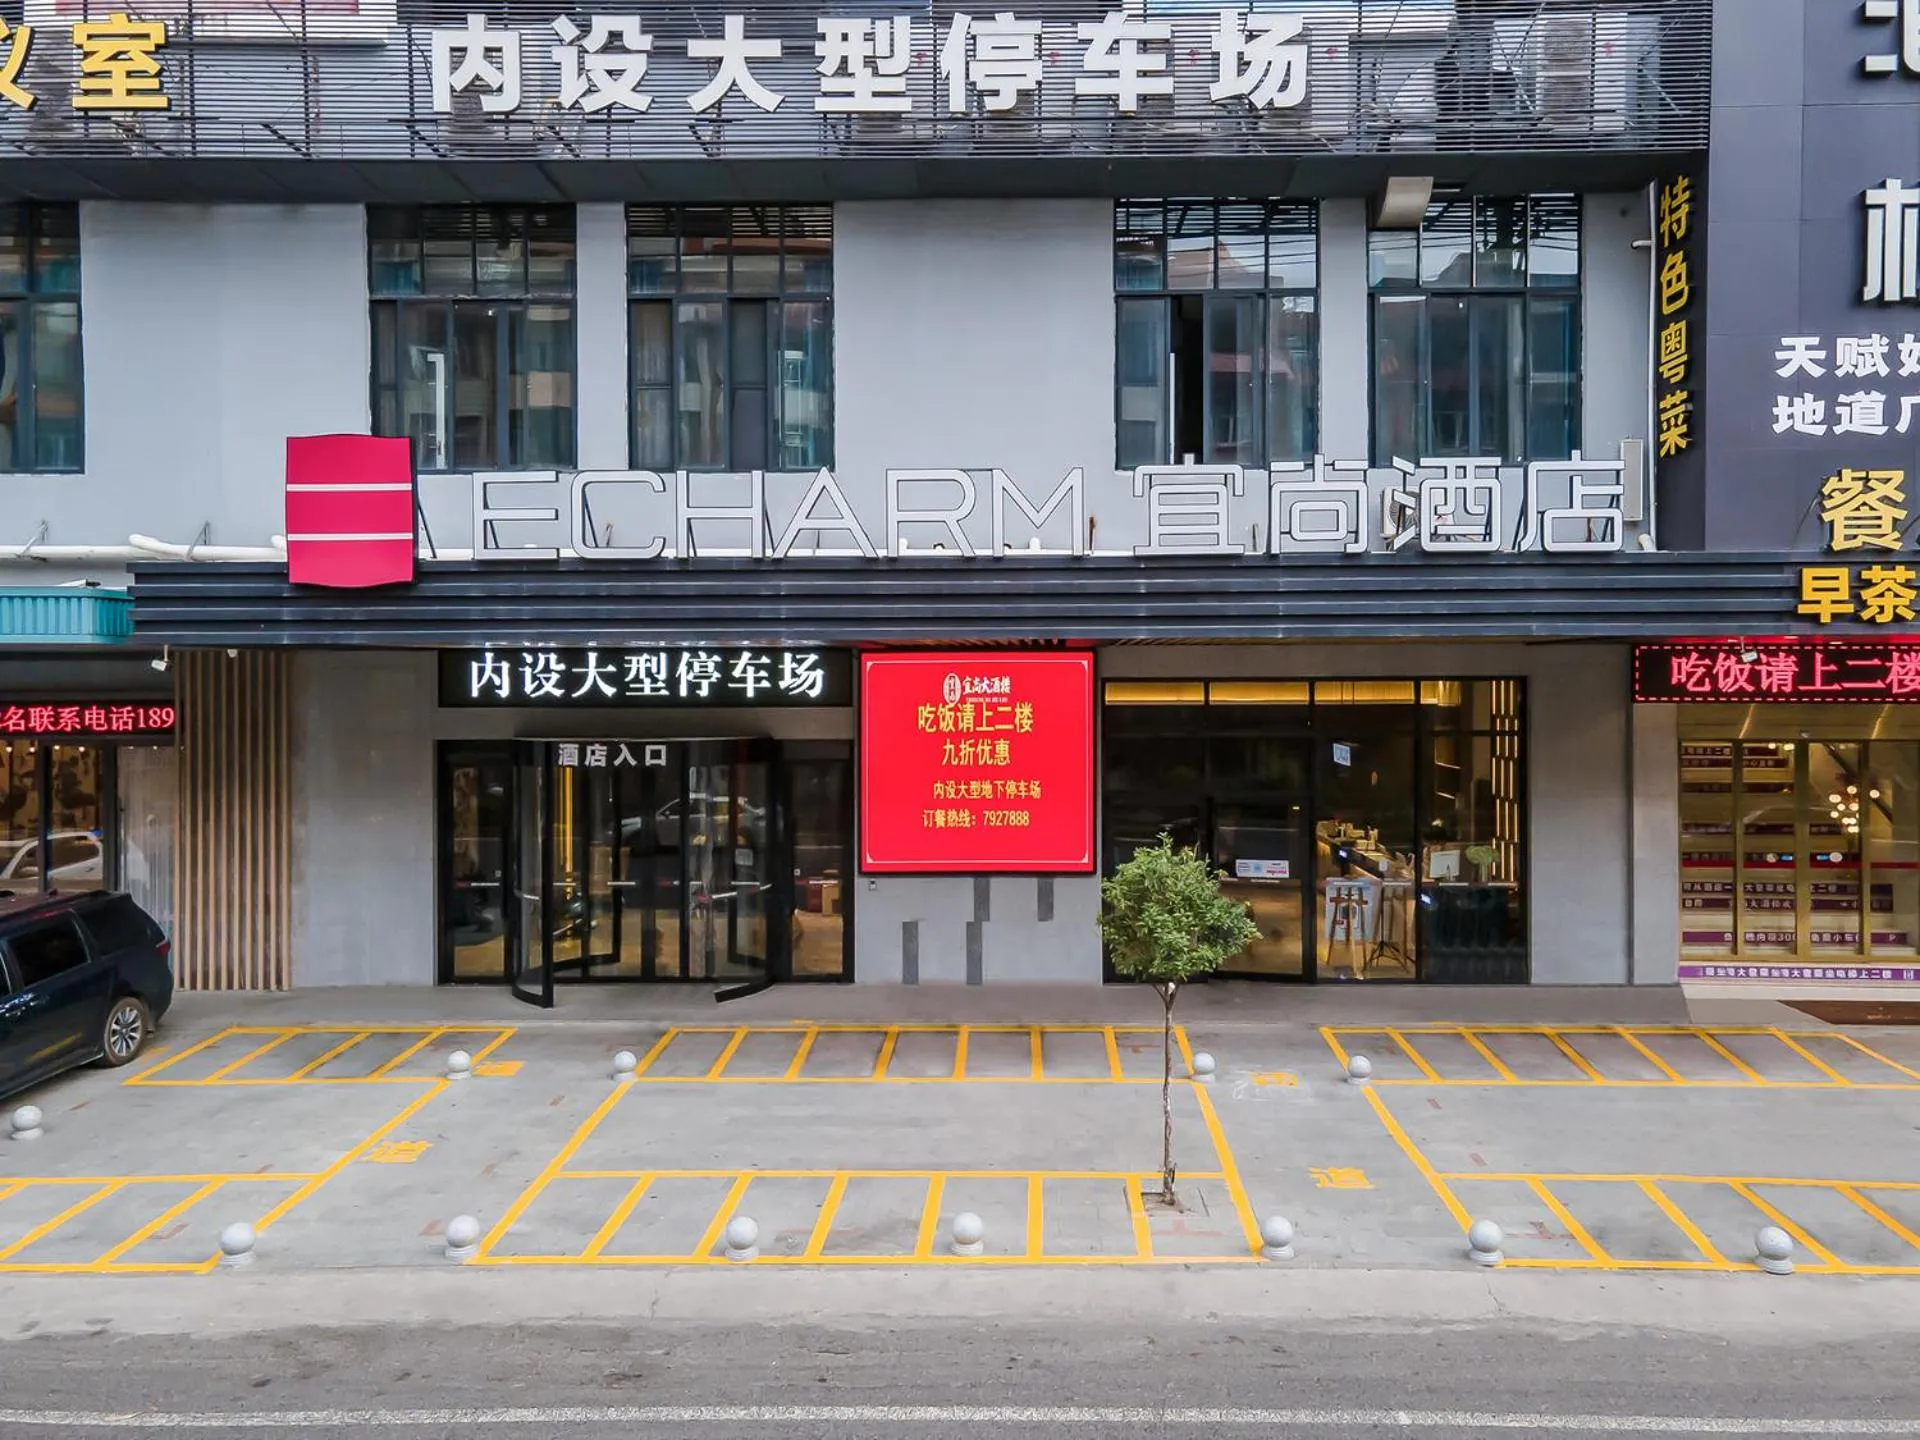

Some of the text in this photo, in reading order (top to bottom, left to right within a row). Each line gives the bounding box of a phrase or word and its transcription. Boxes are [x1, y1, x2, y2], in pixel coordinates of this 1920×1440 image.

[431, 11, 1309, 115] 内设大型停车场
[1658, 175, 1691, 458] 特色粤菜
[472, 449, 1626, 560] ECHARM 宜尚酒店
[1797, 564, 1917, 624] 早茶
[470, 651, 825, 698] 内设大型停车场
[1670, 651, 1920, 695] 吃饭请上二楼
[0, 705, 175, 733] 名联系电话189
[917, 702, 1034, 733] 吃饭请上二楼
[557, 743, 668, 767] 酒店入口
[941, 738, 1011, 766] 九折优惠
[933, 780, 1041, 800] 内设大型地下停车场
